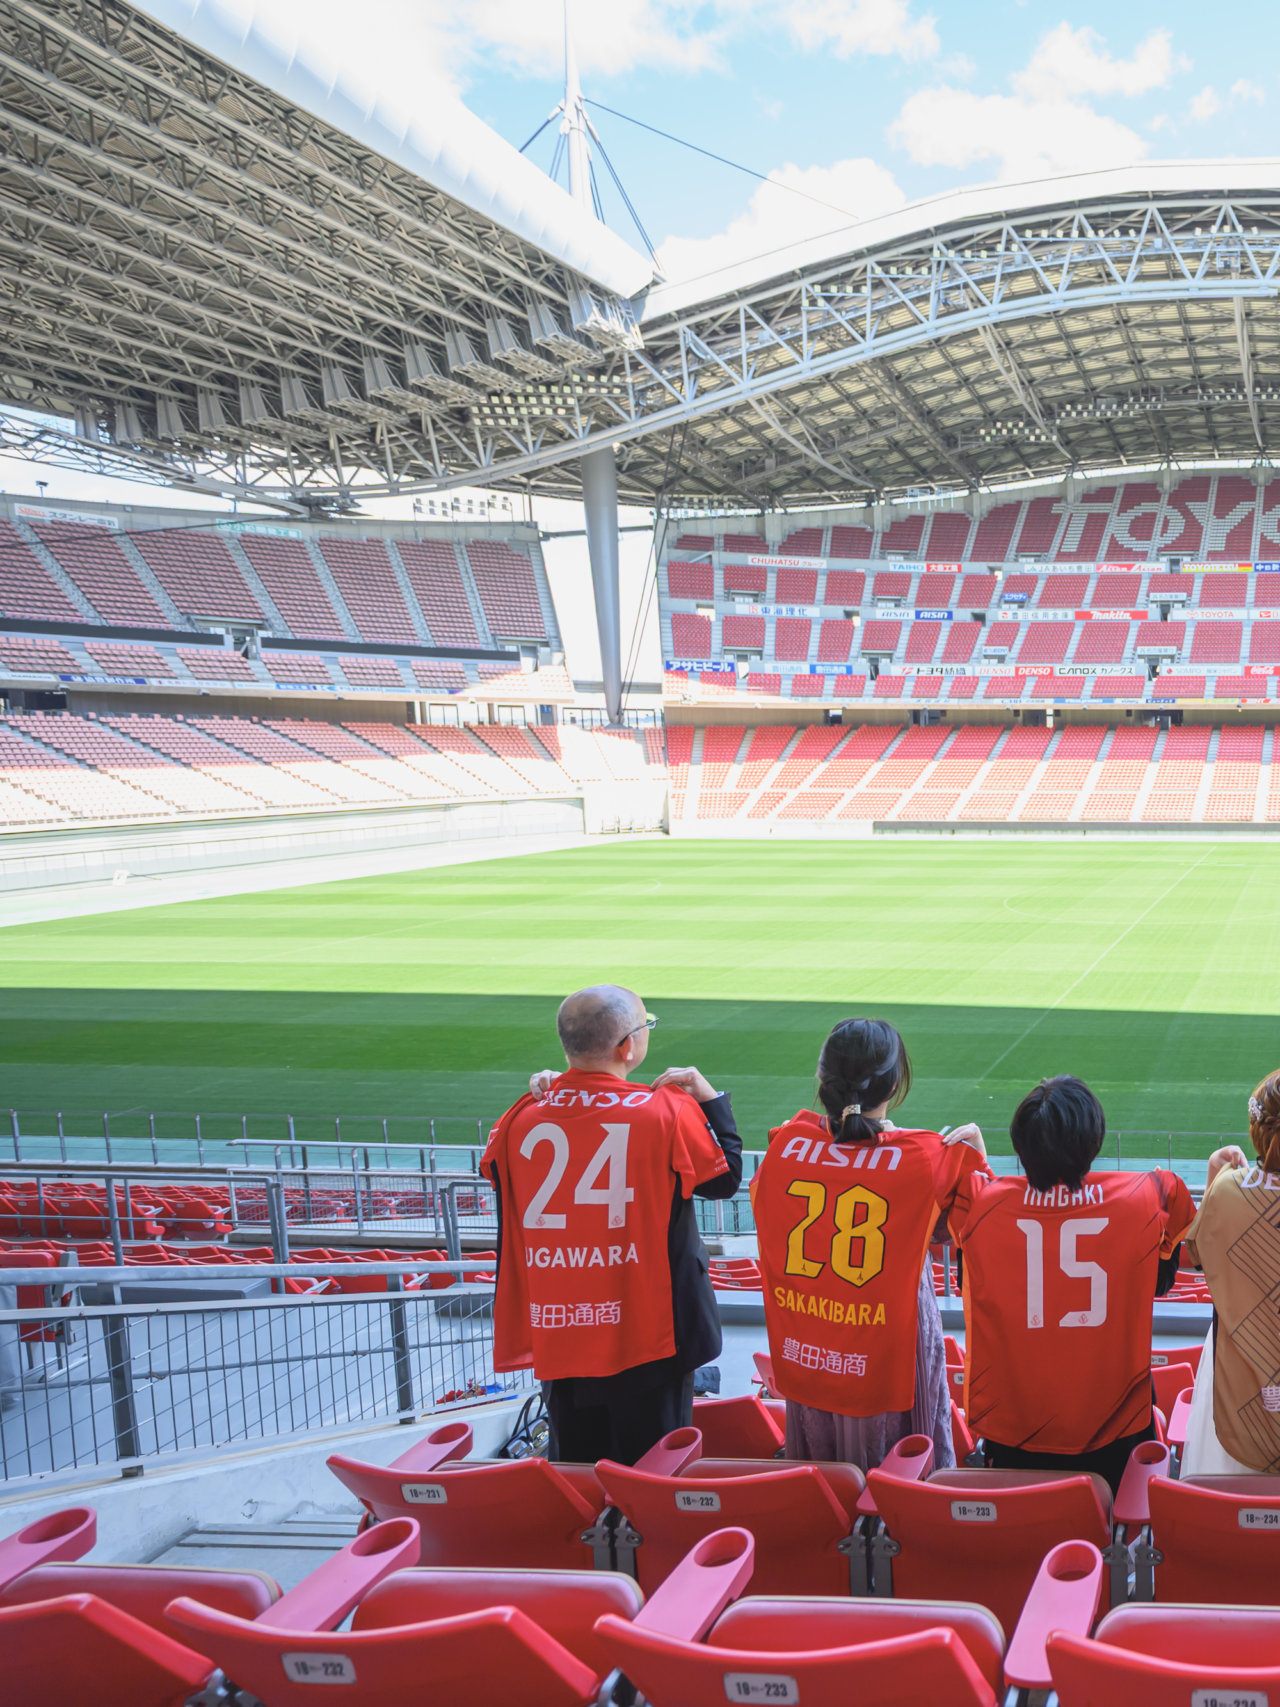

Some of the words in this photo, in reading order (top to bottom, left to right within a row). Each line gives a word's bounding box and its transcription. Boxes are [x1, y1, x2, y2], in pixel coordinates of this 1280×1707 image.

[751, 557, 800, 567] CHUHATSU
[891, 563, 924, 571] TAIHO
[761, 606, 808, 616] 東海理化
[669, 660, 732, 673] アサヒビール
[1018, 667, 1051, 675] DENSO
[1101, 667, 1133, 675] カノークス
[781, 1136, 903, 1170] AISIN
[519, 1122, 635, 1230] 24
[784, 1179, 889, 1288] 28
[1017, 1217, 1110, 1330] 15
[774, 1286, 887, 1326] SAKAKIBARA
[781, 1336, 868, 1378] 豊田通商
